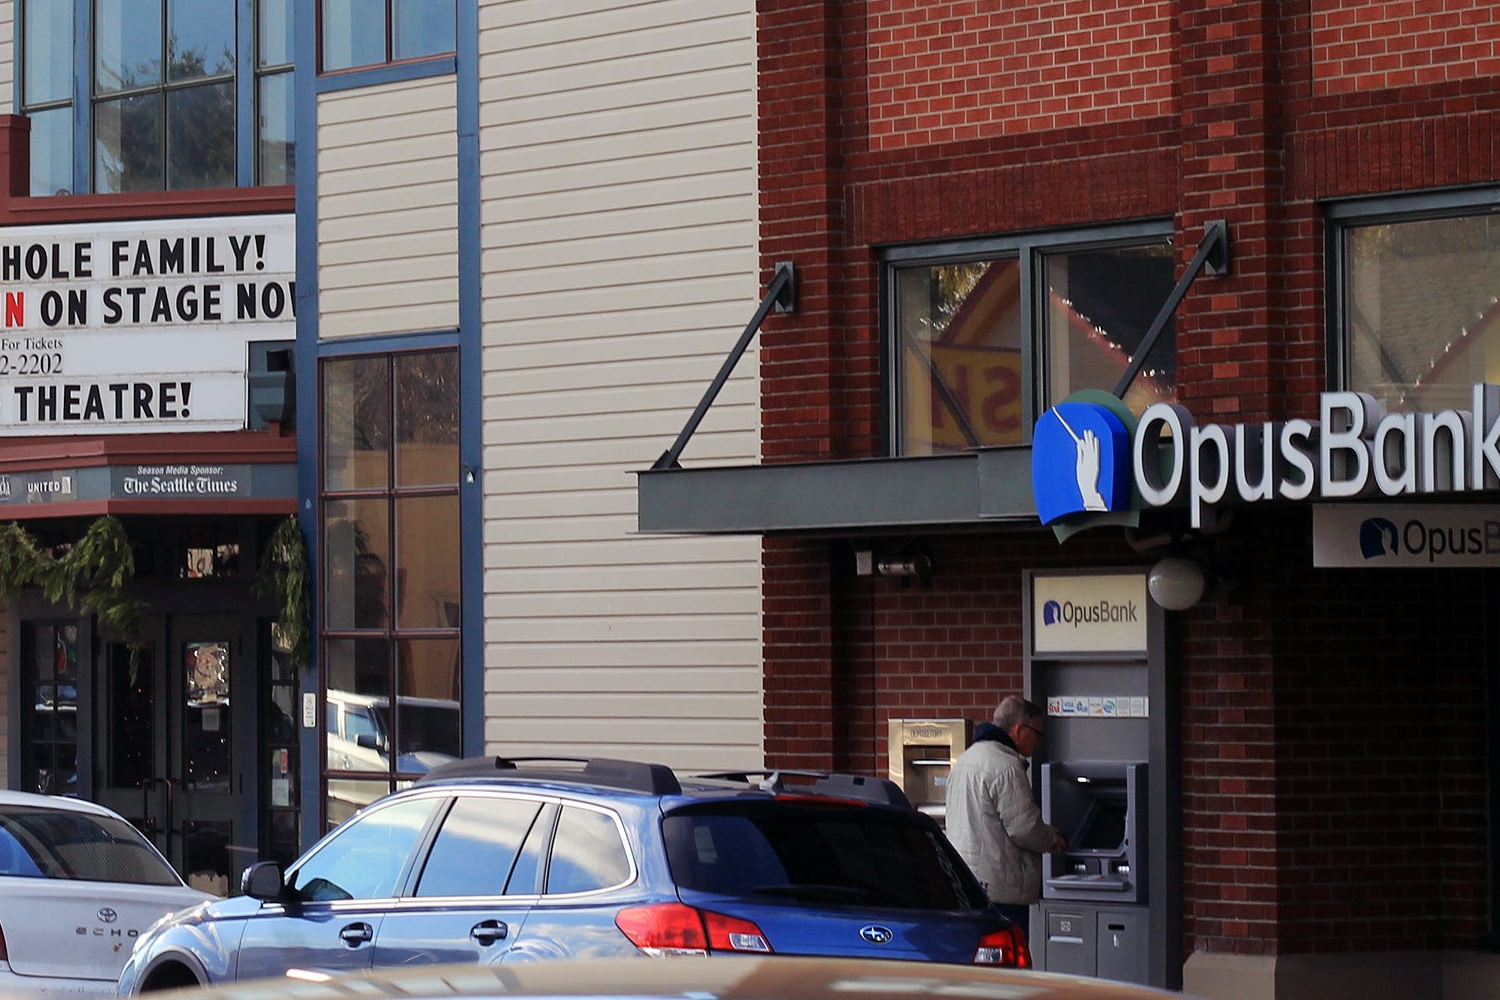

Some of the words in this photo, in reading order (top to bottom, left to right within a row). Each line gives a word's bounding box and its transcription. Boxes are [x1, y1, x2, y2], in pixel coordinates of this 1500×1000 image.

[111, 234, 266, 277] FAMILY!
[40, 289, 88, 326] ON
[103, 284, 221, 325] STAGE
[1, 338, 20, 351] For
[23, 336, 63, 350] Tickets
[14, 381, 192, 422] THEATRE!
[1134, 383, 1500, 528] OpusBank
[138, 467, 163, 475] Season
[166, 466, 188, 475] Media
[191, 465, 224, 476] Sponsor:
[27, 481, 60, 493] UNITED
[123, 477, 149, 495] The
[151, 477, 195, 494] Seattle
[196, 475, 238, 493] Times
[1063, 600, 1137, 628] OpusBank
[76, 927, 139, 937] ECHO
